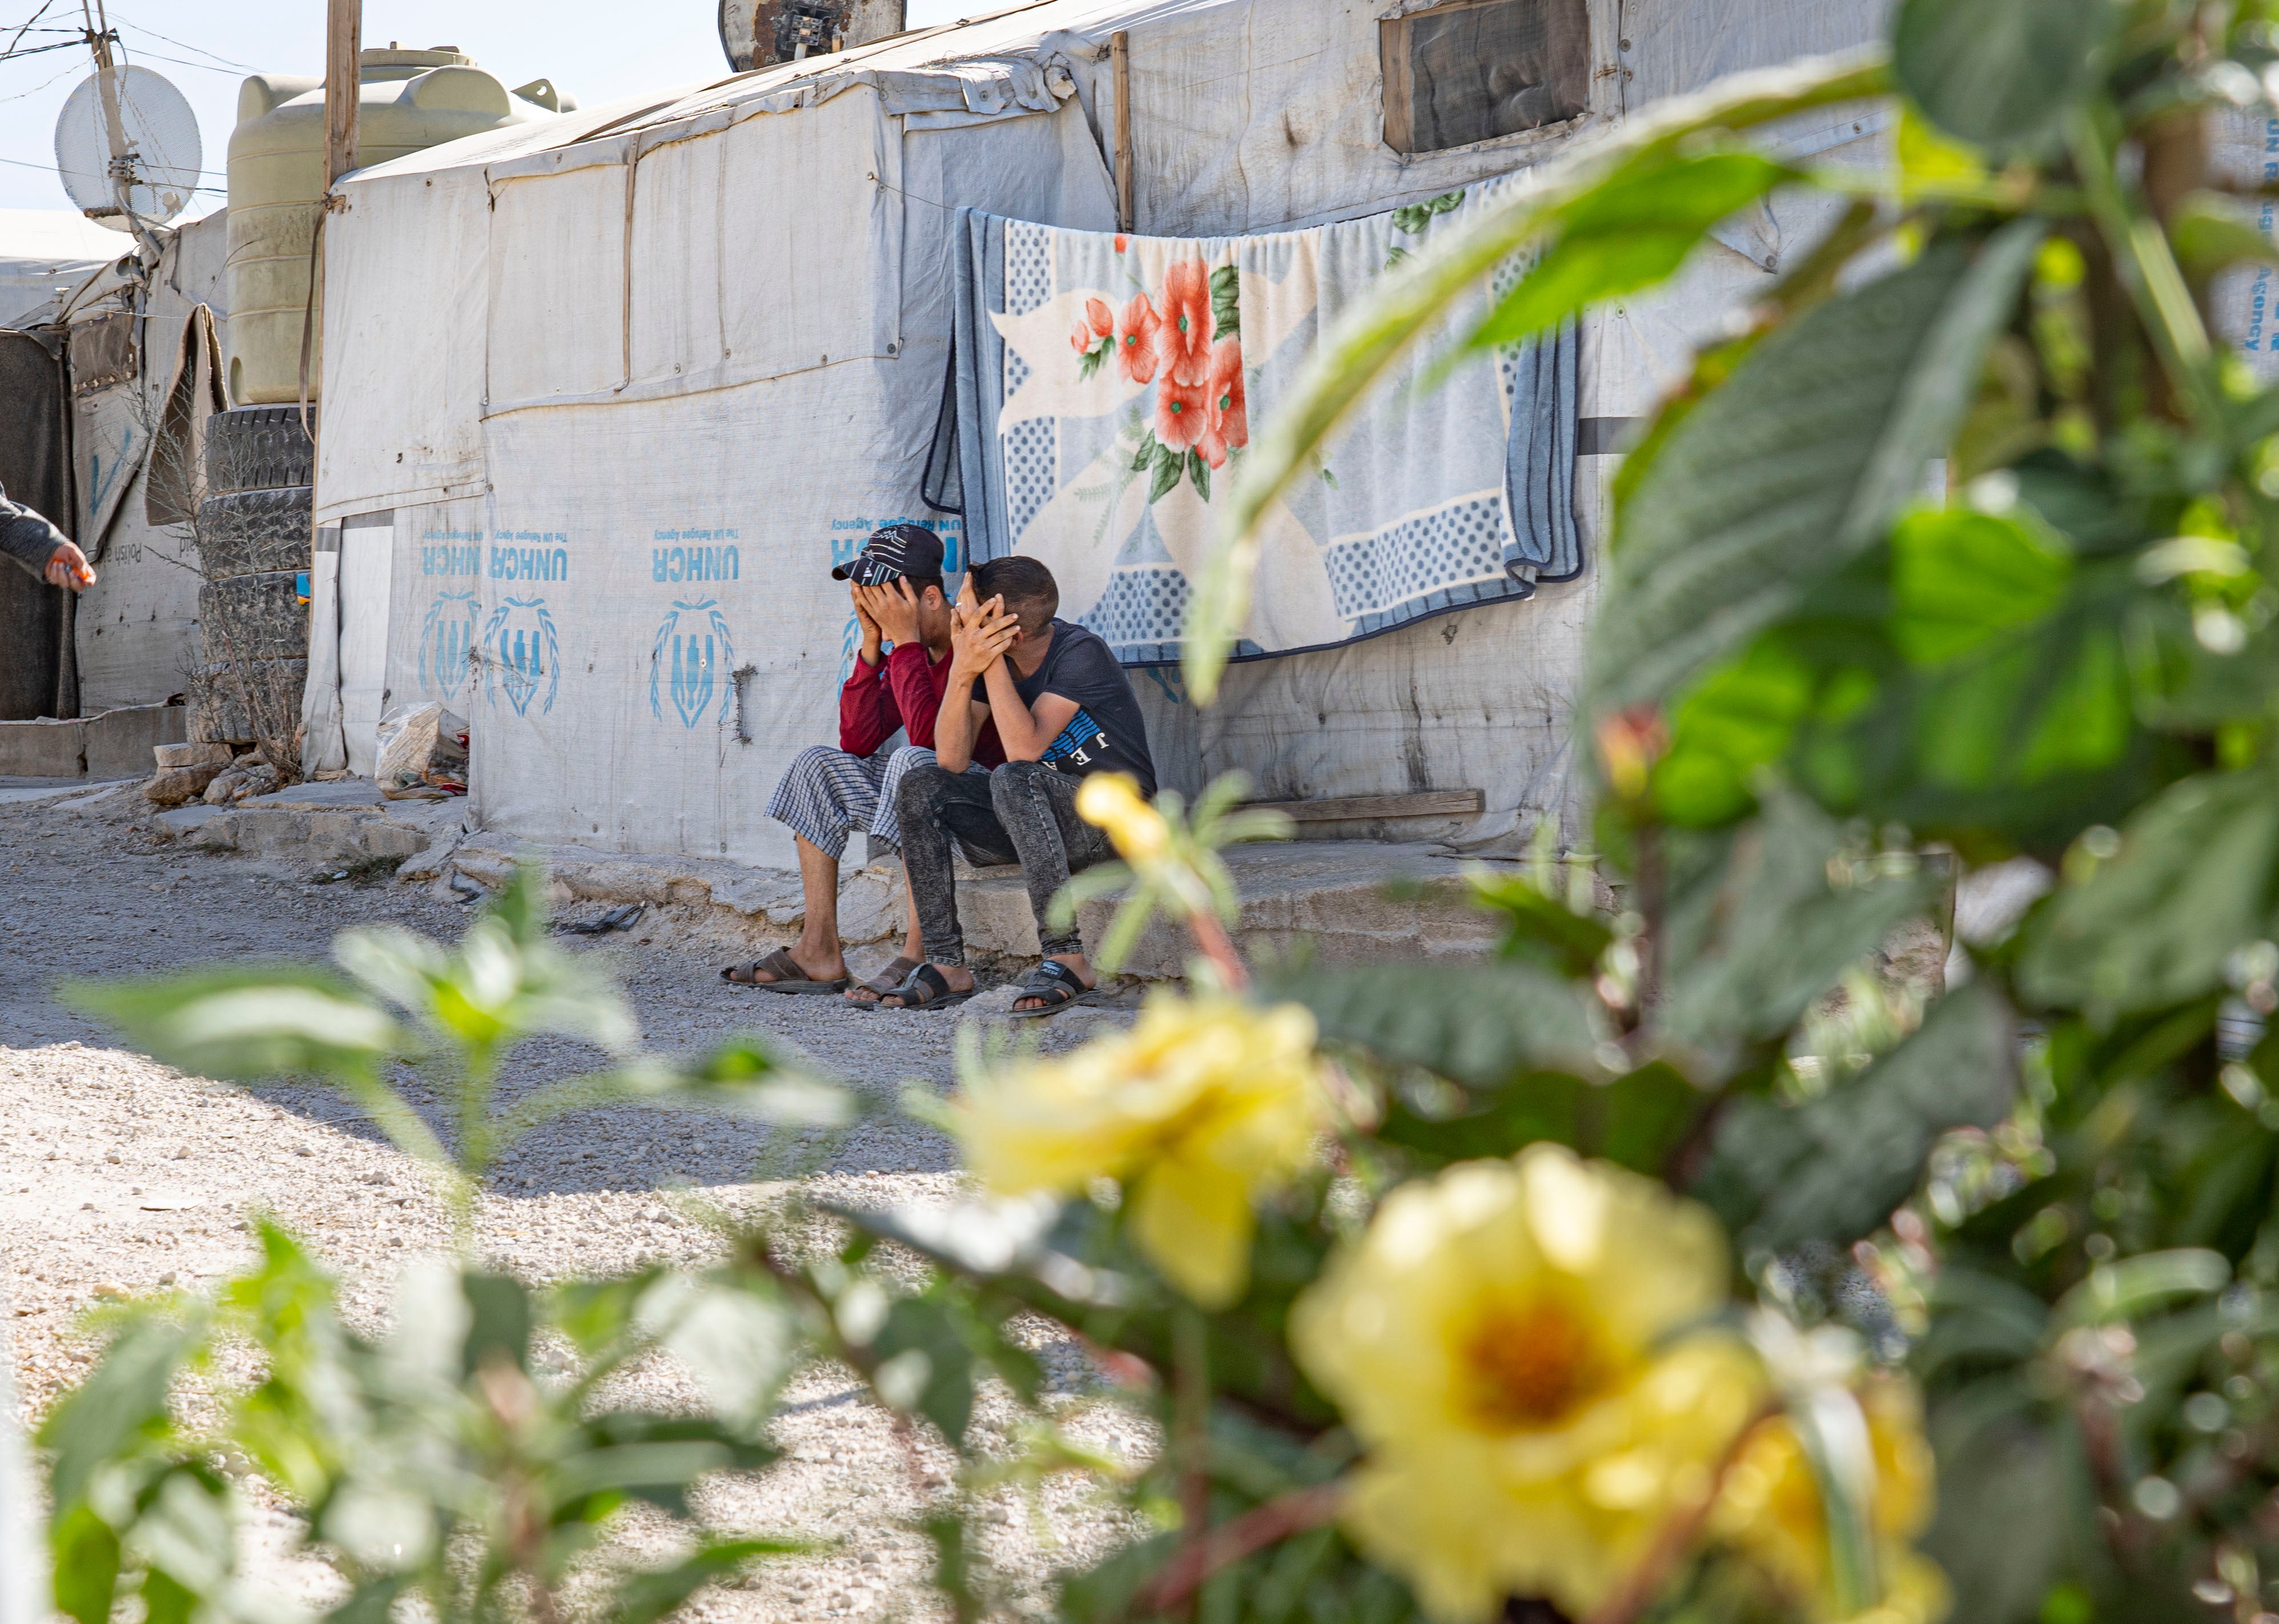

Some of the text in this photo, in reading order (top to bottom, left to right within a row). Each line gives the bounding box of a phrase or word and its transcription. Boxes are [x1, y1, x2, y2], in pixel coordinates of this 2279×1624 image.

[2244, 267, 2272, 351] Agency
[831, 517, 874, 531] Agency
[938, 519, 962, 532] UN
[115, 542, 142, 563] Polish
[422, 545, 481, 576] NHCR
[489, 546, 568, 581] UNHCR
[652, 545, 739, 582] UNHCR
